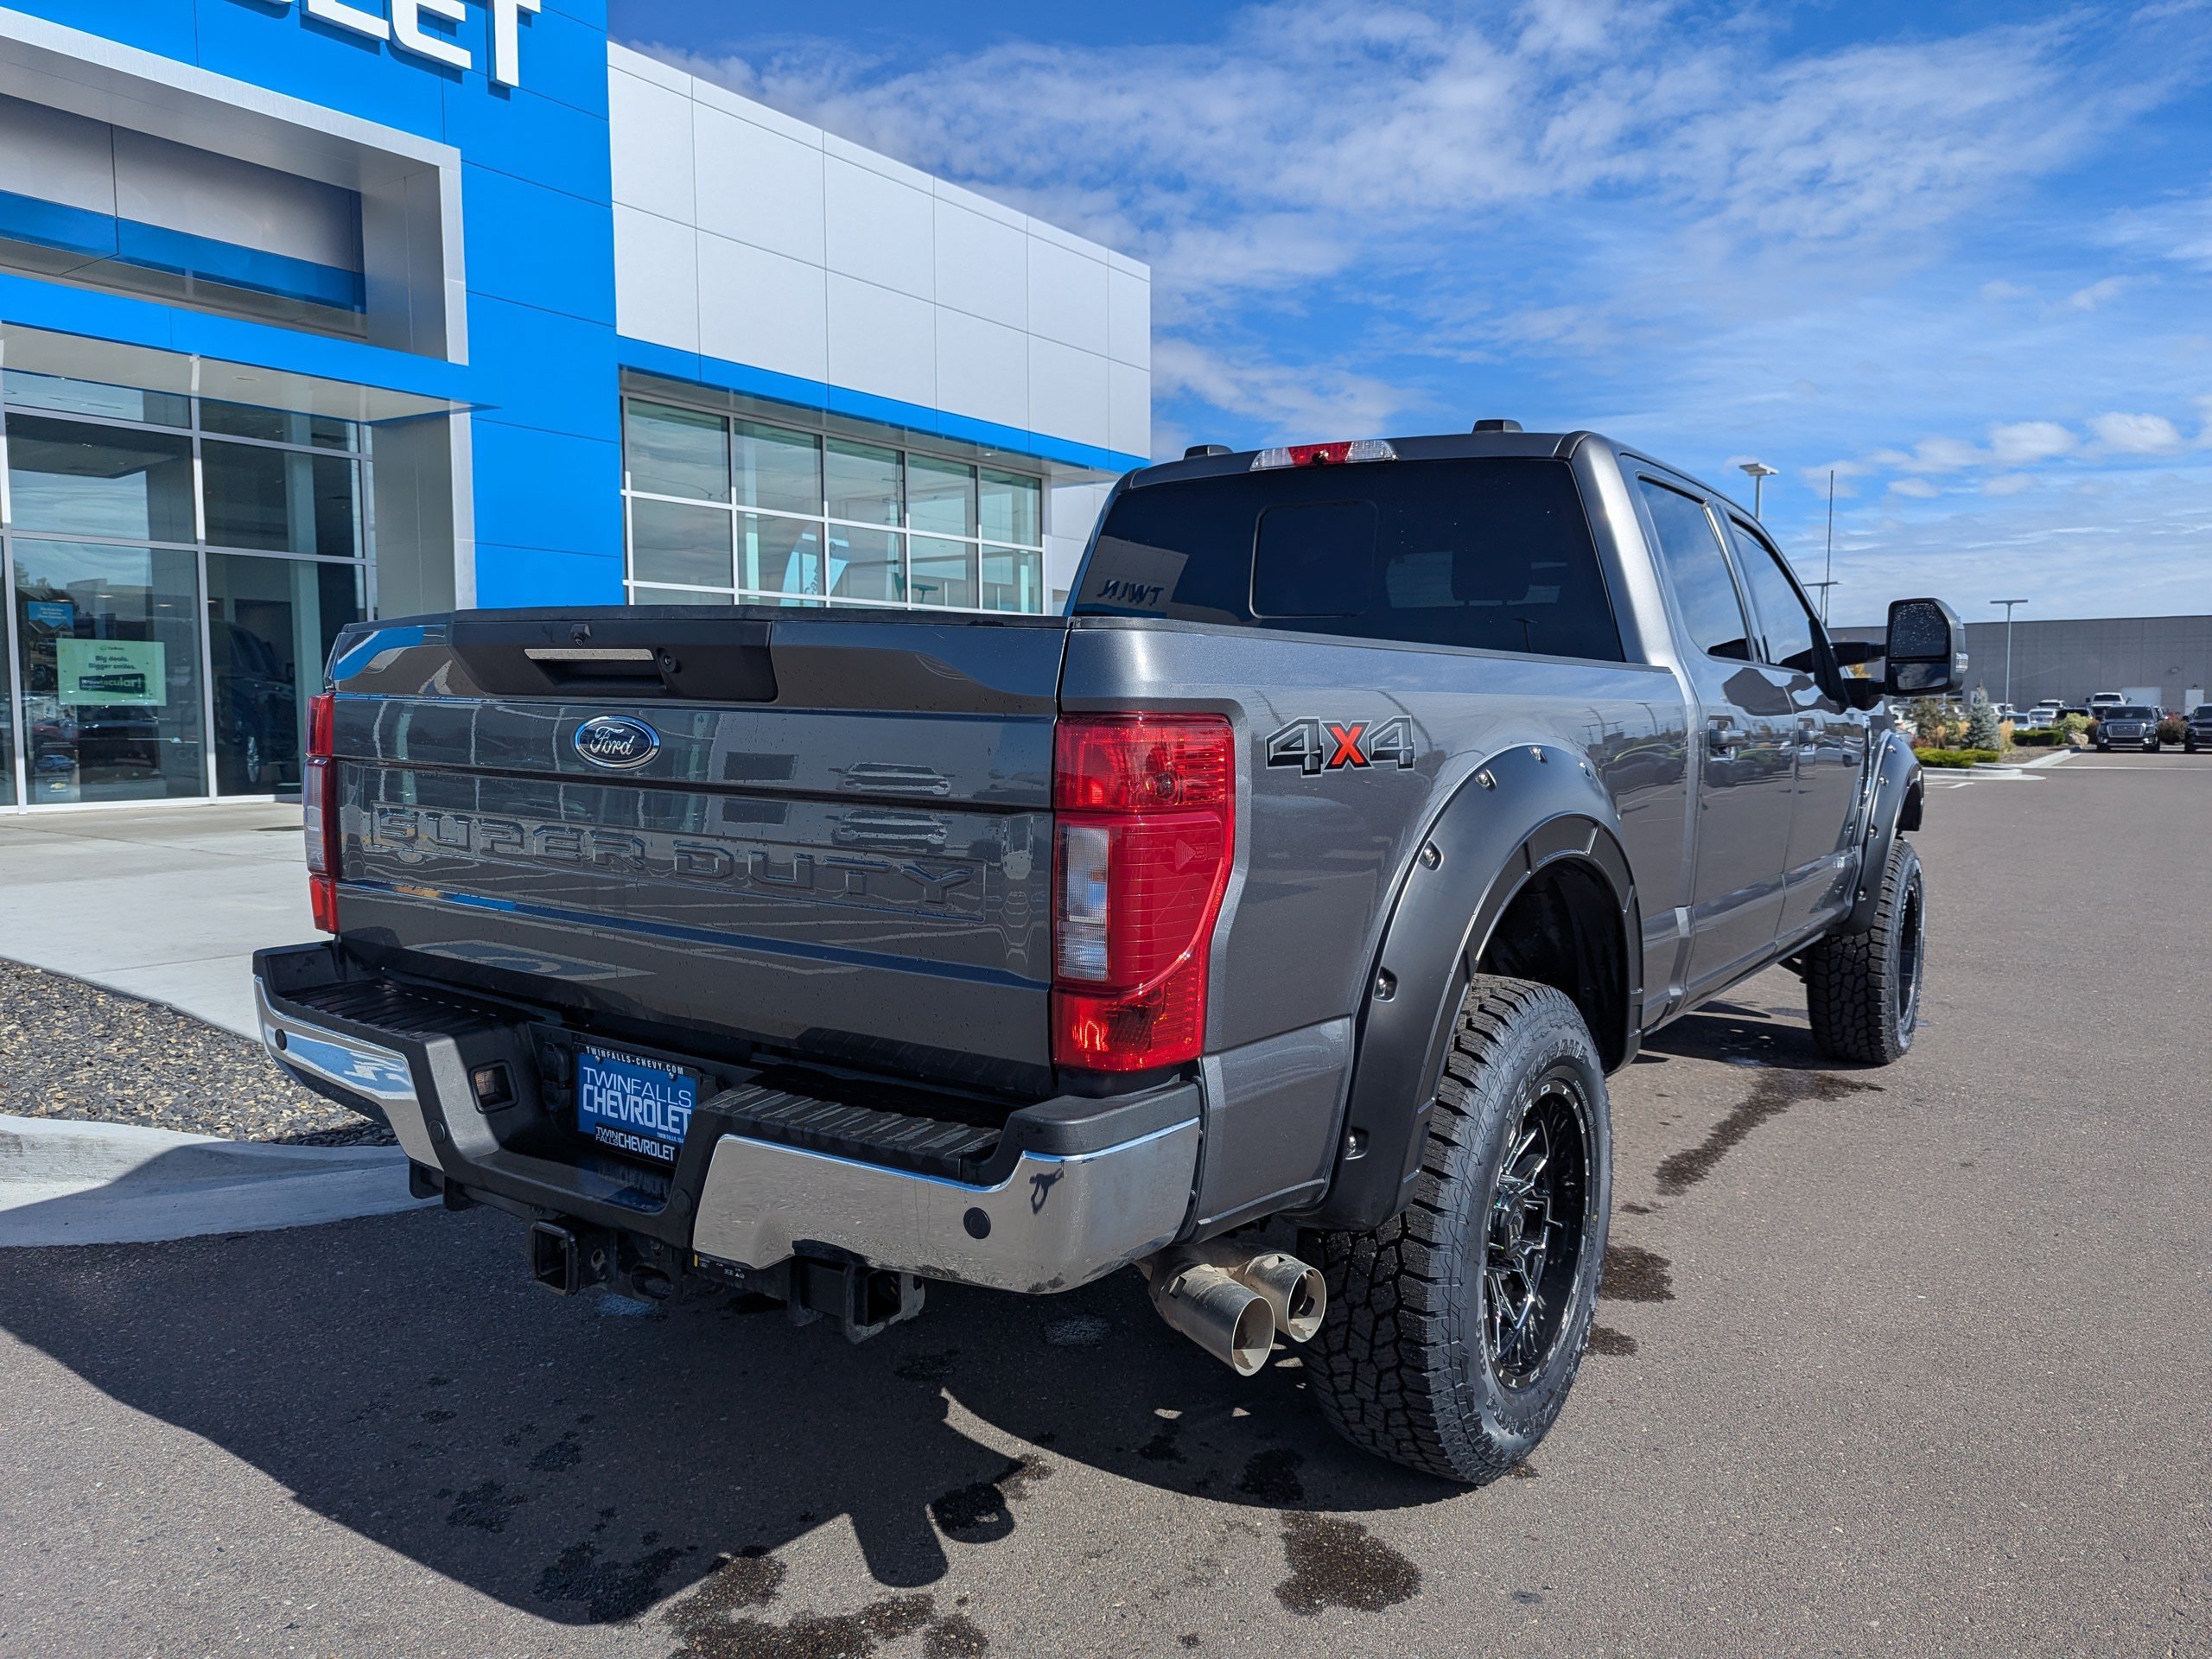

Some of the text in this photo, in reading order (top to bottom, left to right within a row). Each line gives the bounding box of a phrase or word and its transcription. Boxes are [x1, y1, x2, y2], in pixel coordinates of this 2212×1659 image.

[95, 655, 107, 664] Big
[589, 726, 635, 755] Ford
[379, 810, 974, 906] SUPER DUTY
[585, 1046, 684, 1076] TWINFALLS-CHEVY.COM
[1506, 1039, 1589, 1125] YOKOHAMA
[582, 1084, 692, 1136] CHEVROLET
[595, 1126, 619, 1140] TWIN
[595, 1135, 619, 1147] FALLS
[618, 1132, 676, 1162] CHEVROLET
